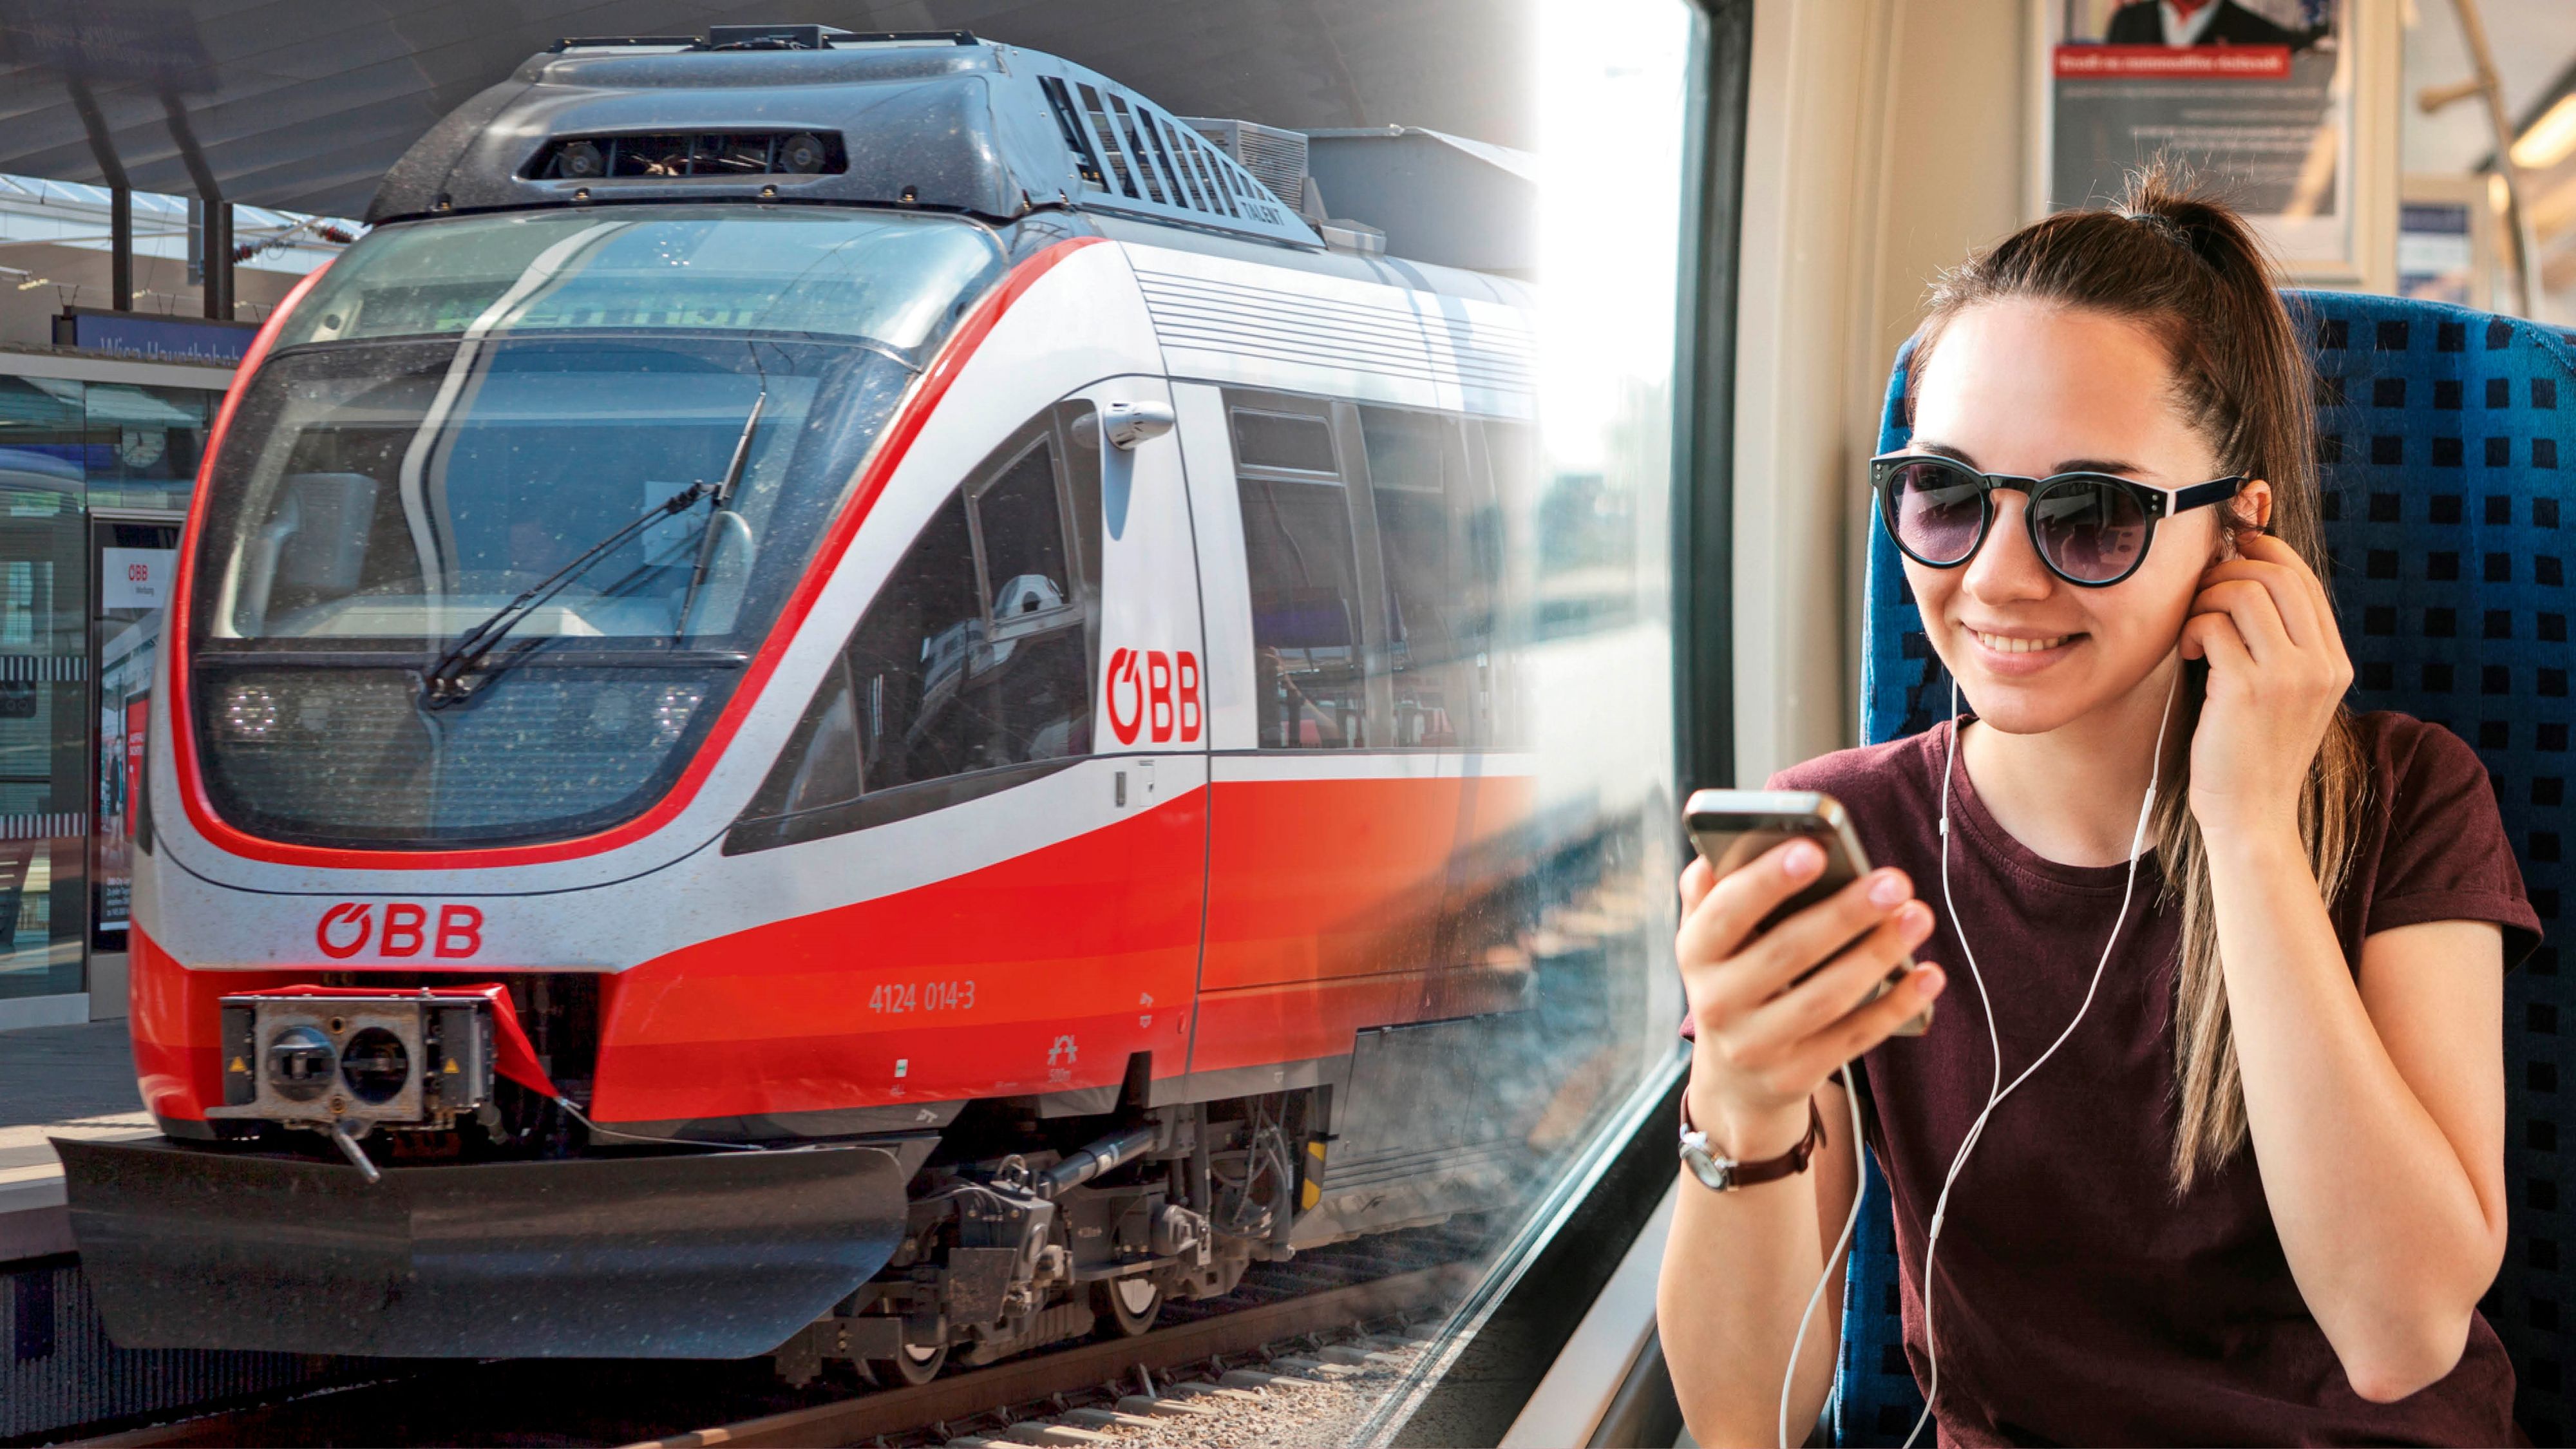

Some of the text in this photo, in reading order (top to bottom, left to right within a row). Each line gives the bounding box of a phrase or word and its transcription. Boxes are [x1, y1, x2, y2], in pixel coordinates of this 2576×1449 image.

[1240, 201, 1285, 226] TALENT
[100, 337, 140, 359] Wien
[129, 564, 148, 581] ÖBB
[1106, 647, 1201, 746] ÖBB
[316, 902, 484, 959] ÖBB
[869, 980, 975, 1014] 4124 014-3
